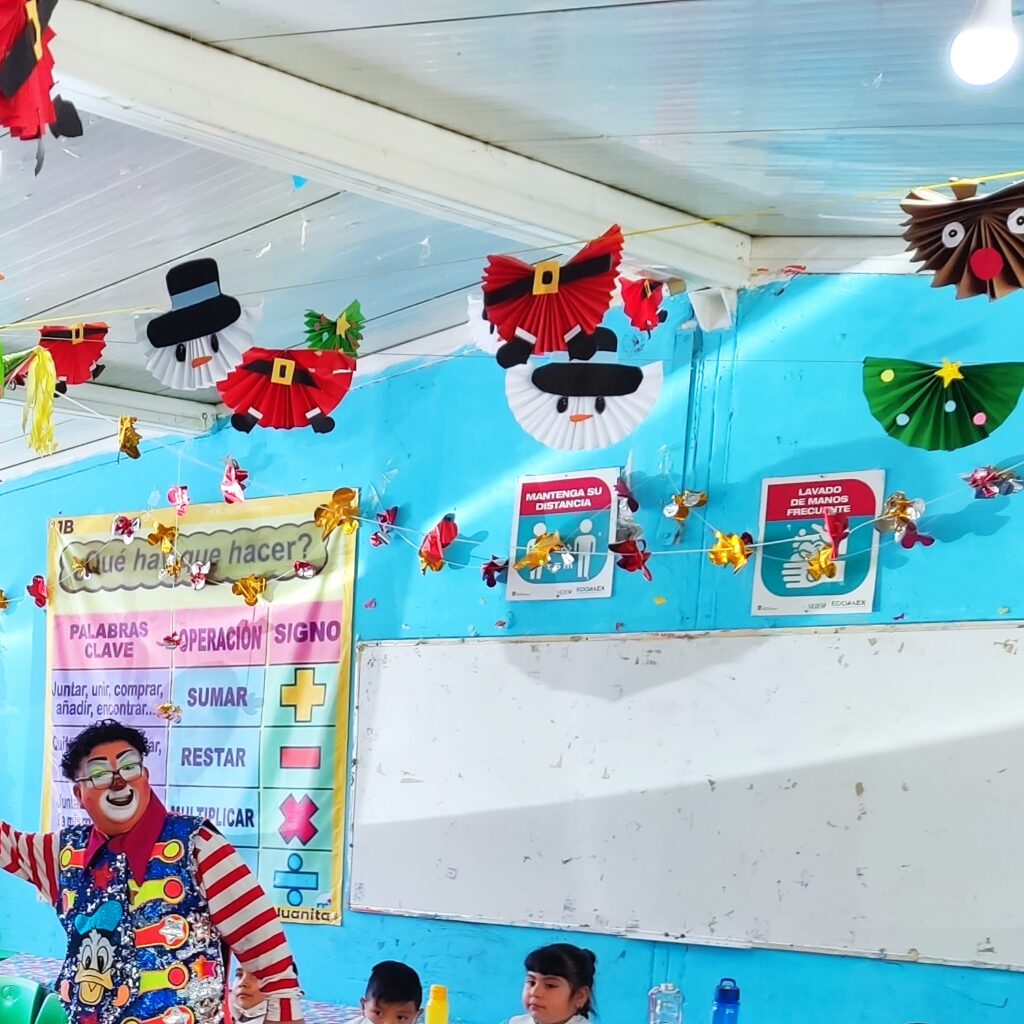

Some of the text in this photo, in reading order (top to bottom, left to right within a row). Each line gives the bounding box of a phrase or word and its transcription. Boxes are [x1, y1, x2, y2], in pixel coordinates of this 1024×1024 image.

[525, 487, 603, 502] MANTENGA SU
[798, 486, 842, 496] LAVADO
[535, 499, 591, 511] DISTANCIA
[790, 495, 849, 507] DE MANOS
[228, 533, 313, 565] hacer?
[69, 621, 149, 640] PALABRAS
[274, 620, 341, 645] SIGNO
[84, 641, 134, 659] CLAVE
[51, 681, 164, 700] Juntar, unir, comprar,
[187, 686, 248, 708] SUMAR
[55, 700, 94, 718] añadir,
[180, 746, 246, 768] RESTAR
